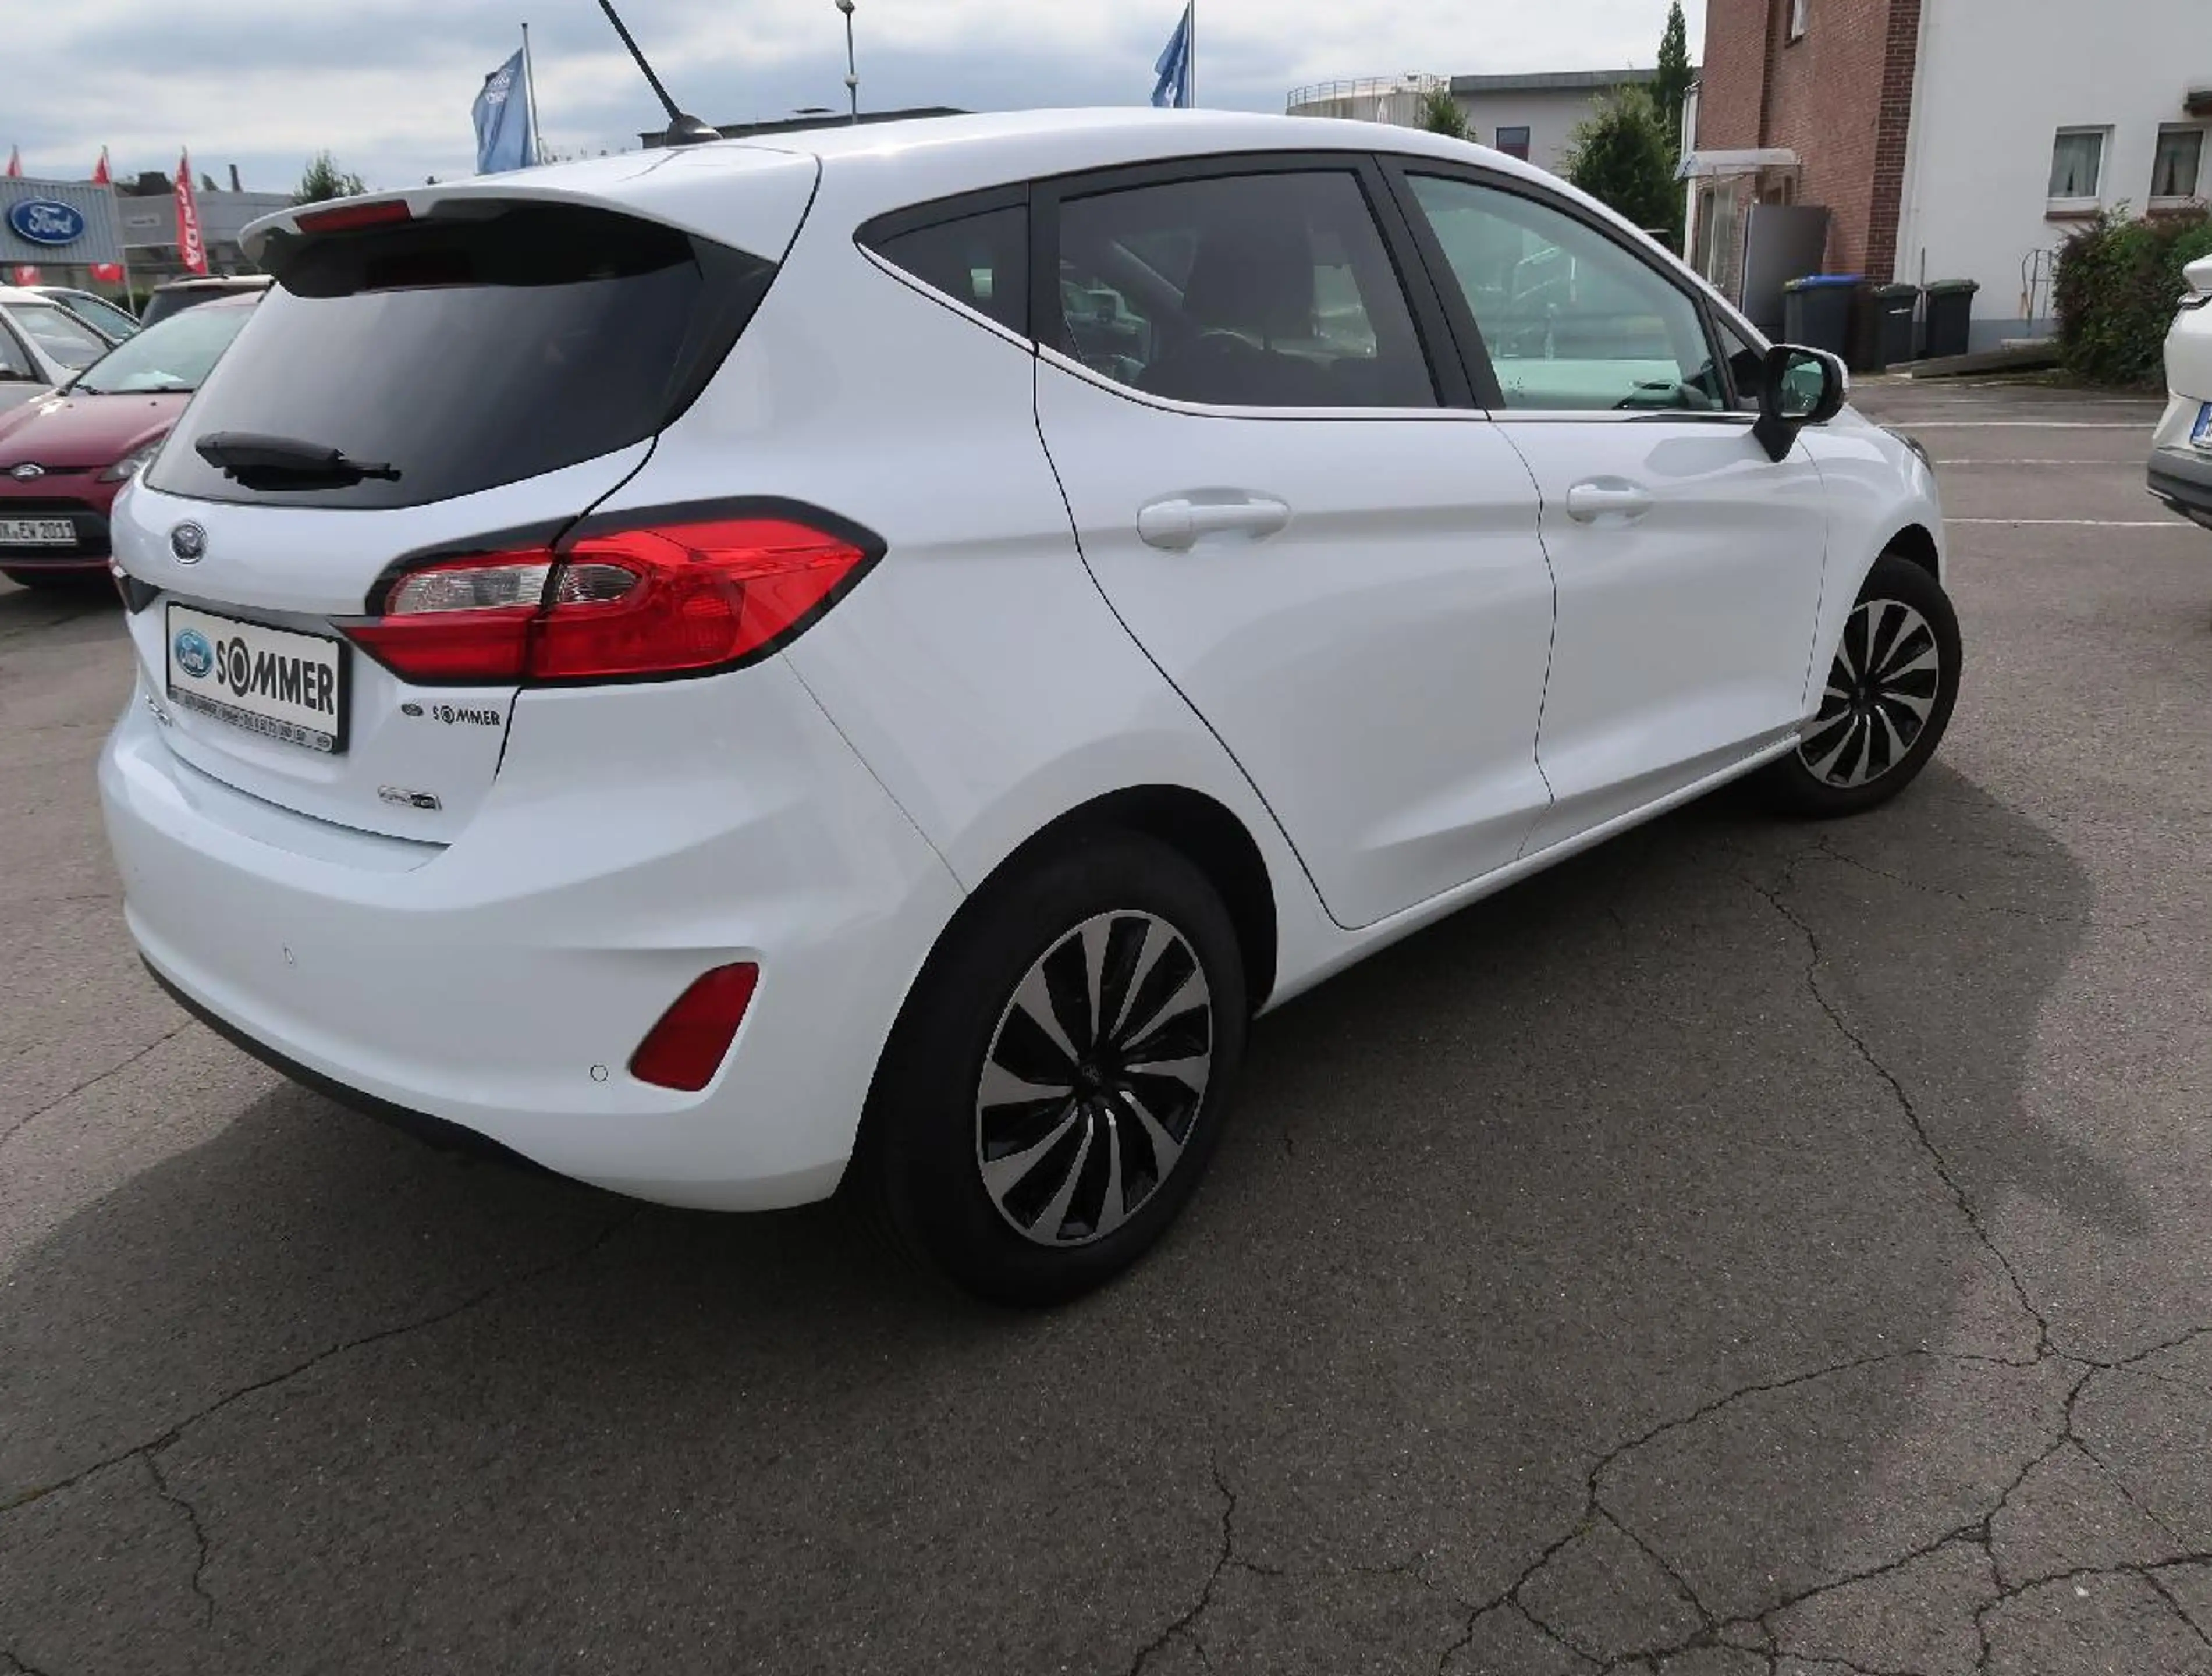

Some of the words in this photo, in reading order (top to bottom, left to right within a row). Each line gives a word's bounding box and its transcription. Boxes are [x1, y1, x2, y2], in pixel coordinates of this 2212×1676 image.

[28, 205, 72, 233] Ford
[216, 637, 334, 715] SOMMER
[432, 705, 501, 725] SOMMER
